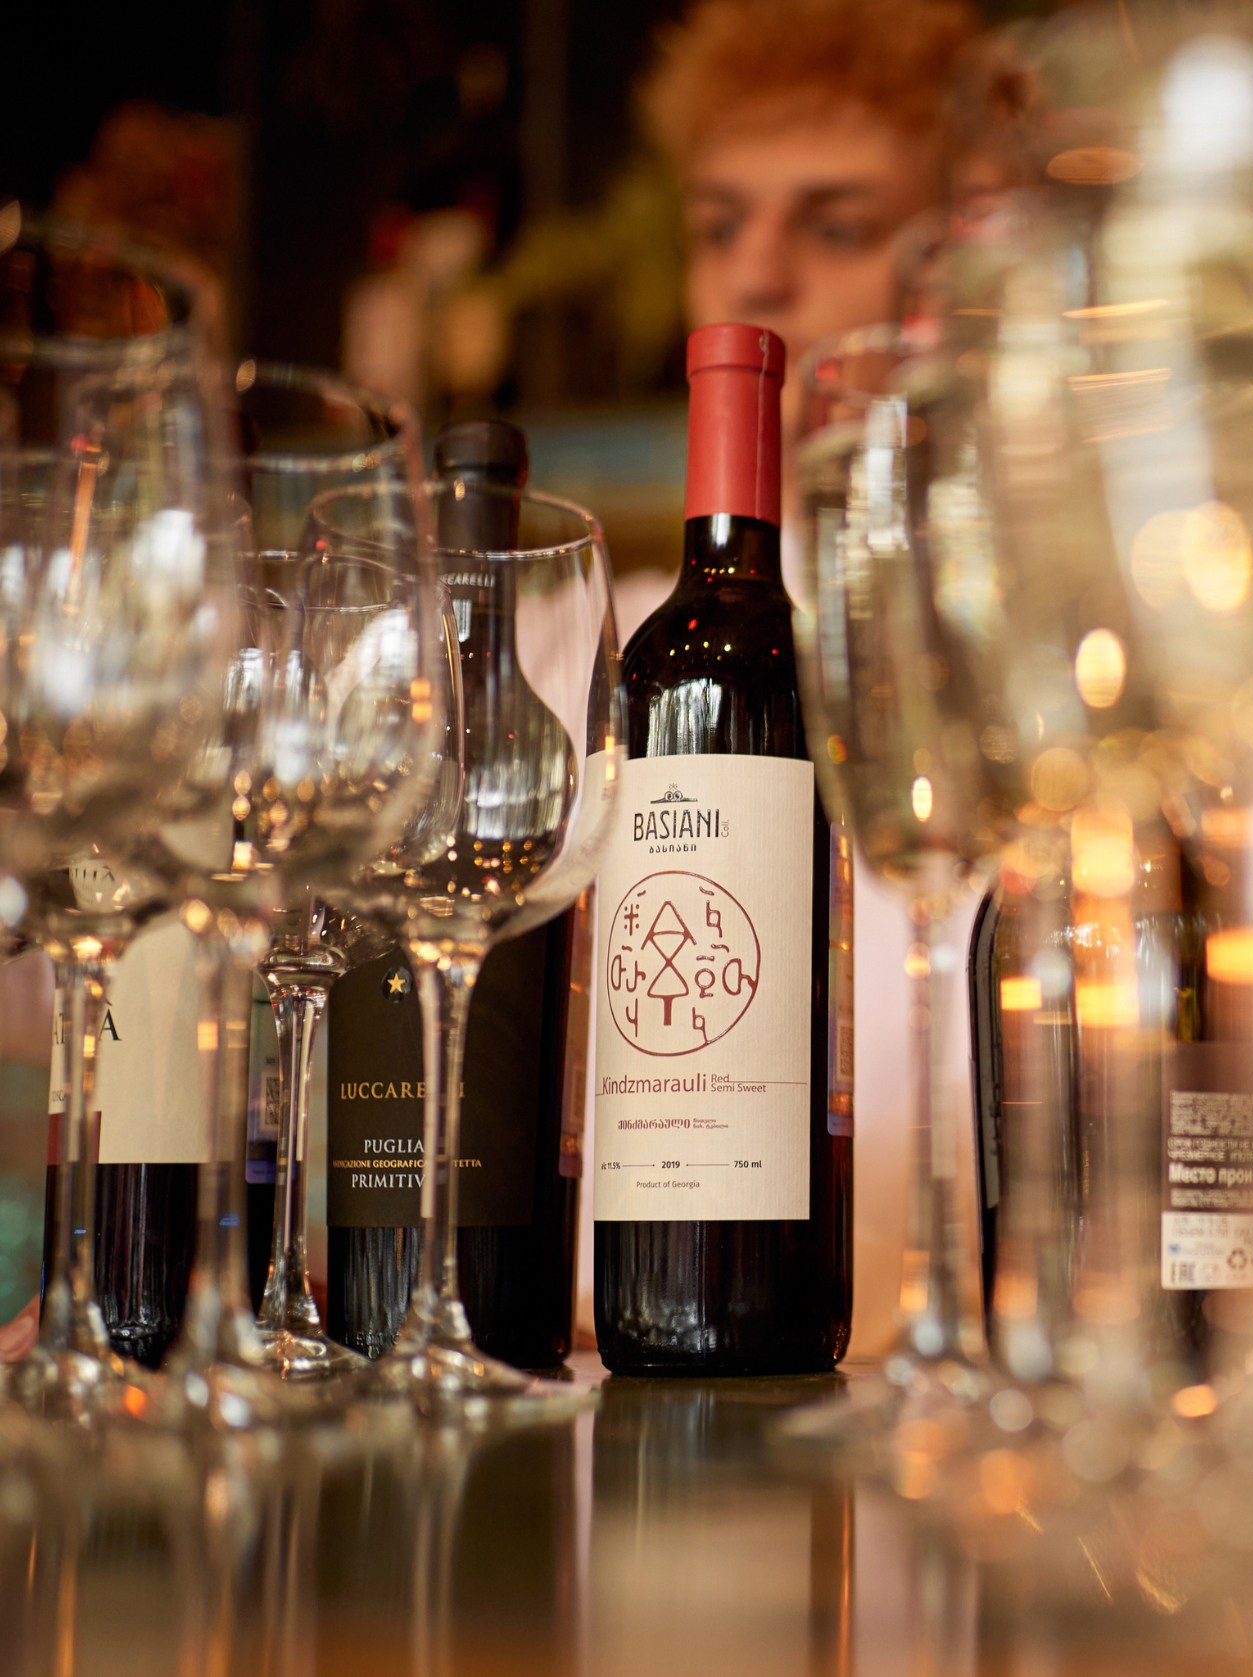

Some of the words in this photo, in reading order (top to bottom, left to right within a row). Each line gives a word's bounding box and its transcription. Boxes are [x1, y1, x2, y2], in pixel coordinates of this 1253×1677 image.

[634, 809, 720, 842] BASIANI
[602, 1073, 707, 1095] Kindzmarauli
[711, 1074, 730, 1083] Red
[341, 1081, 465, 1100] LUCCAREI
[711, 1083, 735, 1093] Semi
[737, 1083, 767, 1093] Sweet
[364, 1139, 425, 1154] PUGLIA
[373, 1159, 426, 1168] GEOGRAFIC
[661, 1160, 681, 1169] 2019
[734, 1160, 749, 1169] 750
[751, 1159, 762, 1169] ml
[1169, 1162, 1217, 1184] Место
[351, 1173, 427, 1189] PRIMITIV
[636, 1180, 661, 1189] Product
[663, 1179, 671, 1188] of
[671, 1179, 700, 1190] Georgia
